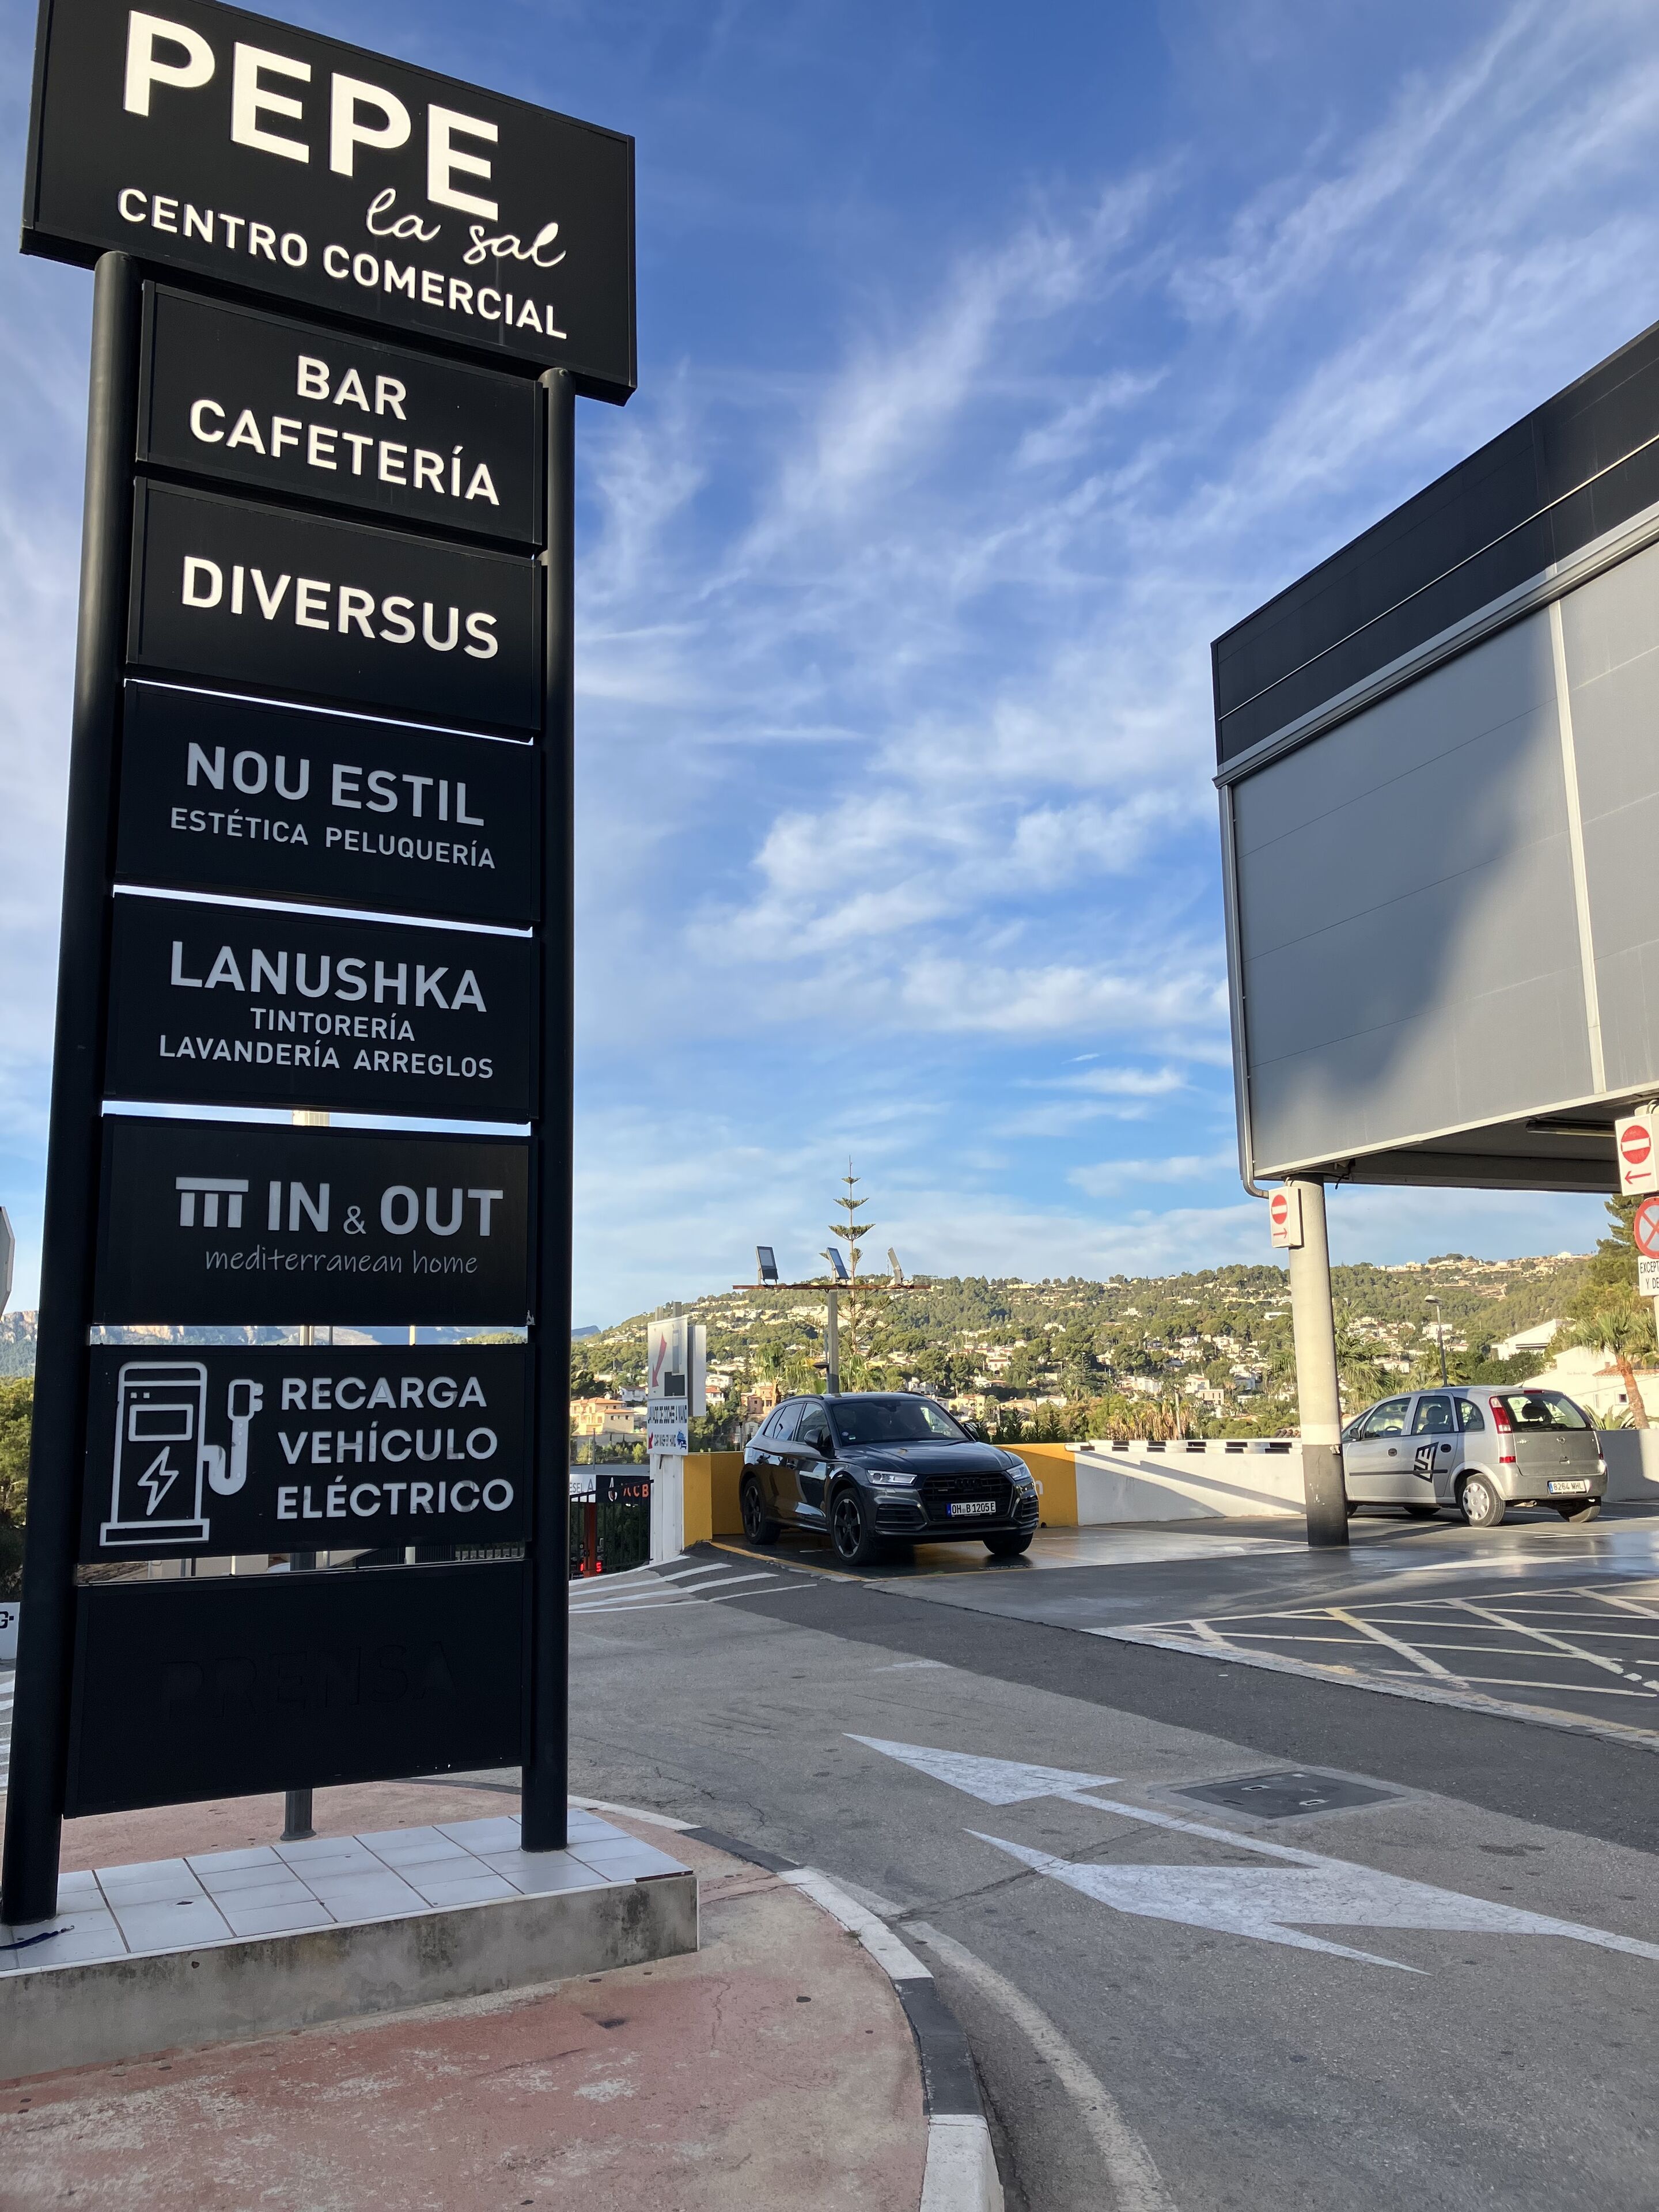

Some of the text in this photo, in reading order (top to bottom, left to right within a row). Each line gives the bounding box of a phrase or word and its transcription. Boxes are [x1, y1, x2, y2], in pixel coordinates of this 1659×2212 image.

[124, 9, 499, 222] PEPE
[366, 187, 567, 267] la sal
[119, 188, 567, 340] CENTRO COMERCIAL
[297, 354, 407, 421] BAR
[190, 399, 501, 506] CAFETERÍA
[181, 555, 499, 660] DIVERSUS
[187, 742, 484, 827] NOU ESTIL
[171, 808, 496, 869] ESTÉTICA PELUQUERÍA
[170, 940, 487, 1013] LANUSHKA
[159, 1034, 494, 1079] LAVANDERÍA ARREGLOS
[250, 1007, 415, 1042] TINTORERÍA
[267, 1180, 504, 1237] IN & OUT
[205, 1244, 478, 1274] mediterranean home
[281, 1376, 488, 1411] RECARGA
[277, 1421, 498, 1465] VEHÍCULO
[276, 1475, 514, 1520] ELÉCTRICO
